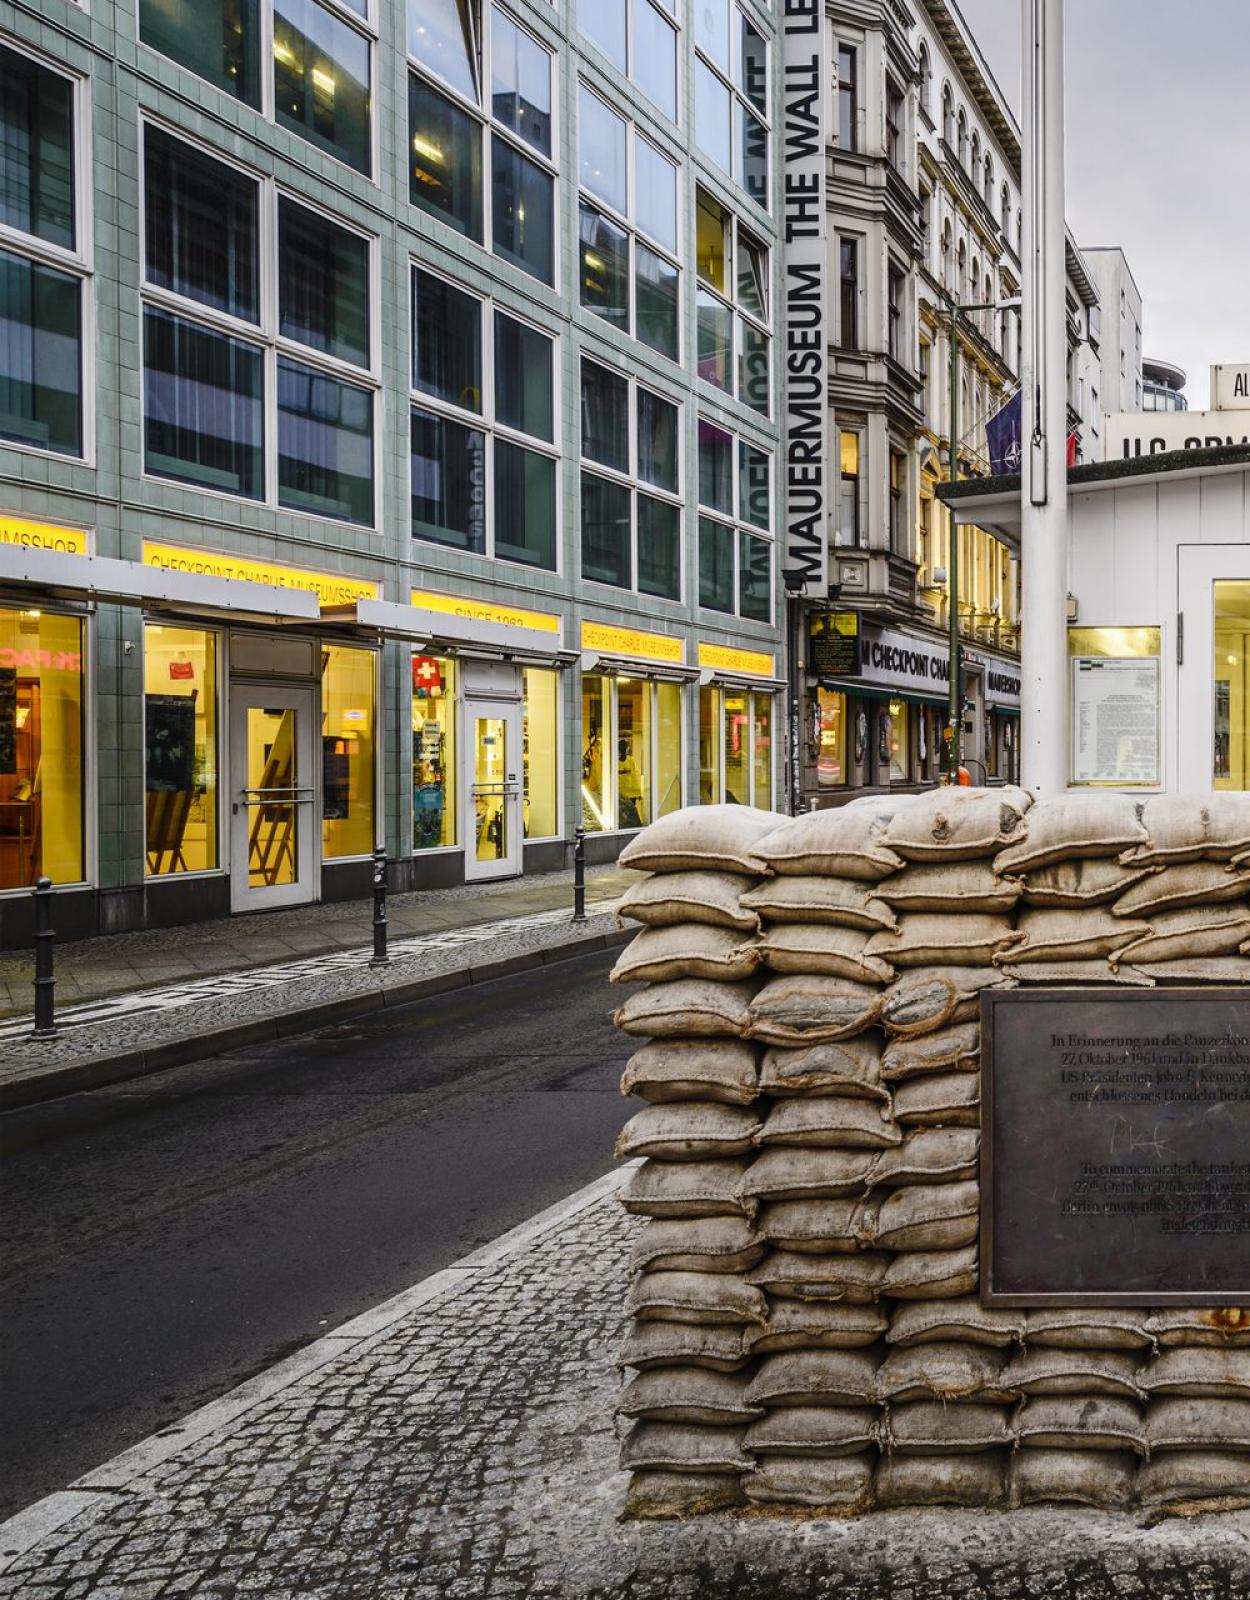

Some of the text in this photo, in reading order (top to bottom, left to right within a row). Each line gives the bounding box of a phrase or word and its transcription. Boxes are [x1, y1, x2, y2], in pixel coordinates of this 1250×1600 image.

[785, 54, 819, 163] WALL
[786, 173, 819, 244] THE
[785, 263, 822, 582] MAUERMUSEUM
[872, 642, 929, 678] CHECKPOINT
[1051, 1034, 1065, 1047] In
[1068, 1034, 1140, 1050] Erinnerung
[1144, 1034, 1159, 1047] an
[1162, 1034, 1180, 1047] die
[1078, 1052, 1128, 1065] Oktober
[1156, 1070, 1182, 1082] John
[1219, 1088, 1238, 1101] bei
